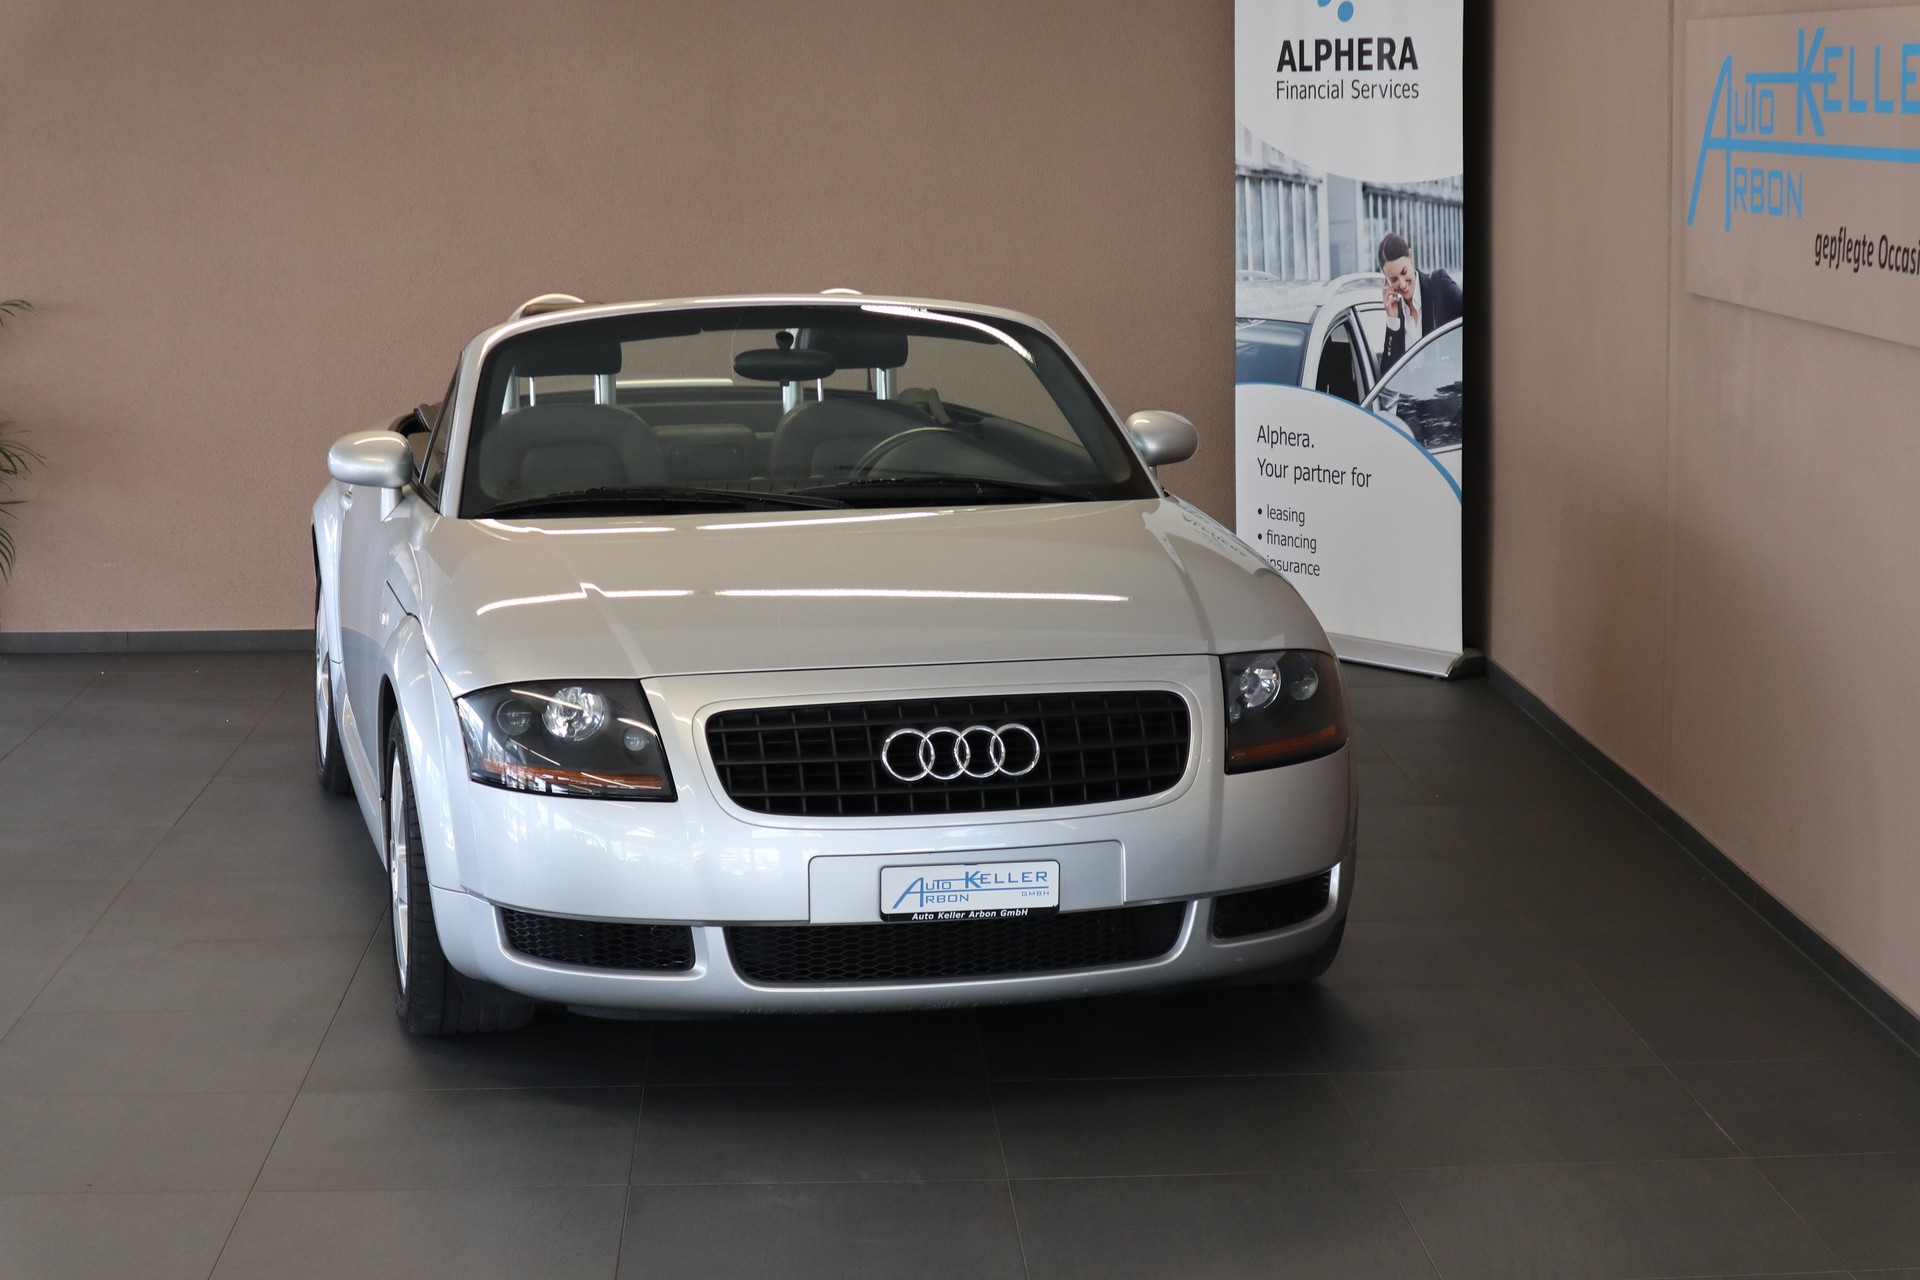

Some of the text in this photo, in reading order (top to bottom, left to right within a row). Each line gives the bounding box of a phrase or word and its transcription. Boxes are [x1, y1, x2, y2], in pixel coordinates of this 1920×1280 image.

[1276, 36, 1419, 73] ALPHERA
[1276, 78, 1420, 100] Financial Services
[1814, 226, 1875, 274] gepflegte
[1256, 424, 1316, 449] Alphera.
[1257, 457, 1373, 488] Your partner for
[1266, 503, 1306, 527] leasing
[1266, 529, 1317, 554] financing
[964, 870, 1048, 889] KELLER
[1021, 890, 1050, 898] GMBH
[911, 908, 1029, 921] Auto Keller Arbon GmbH
